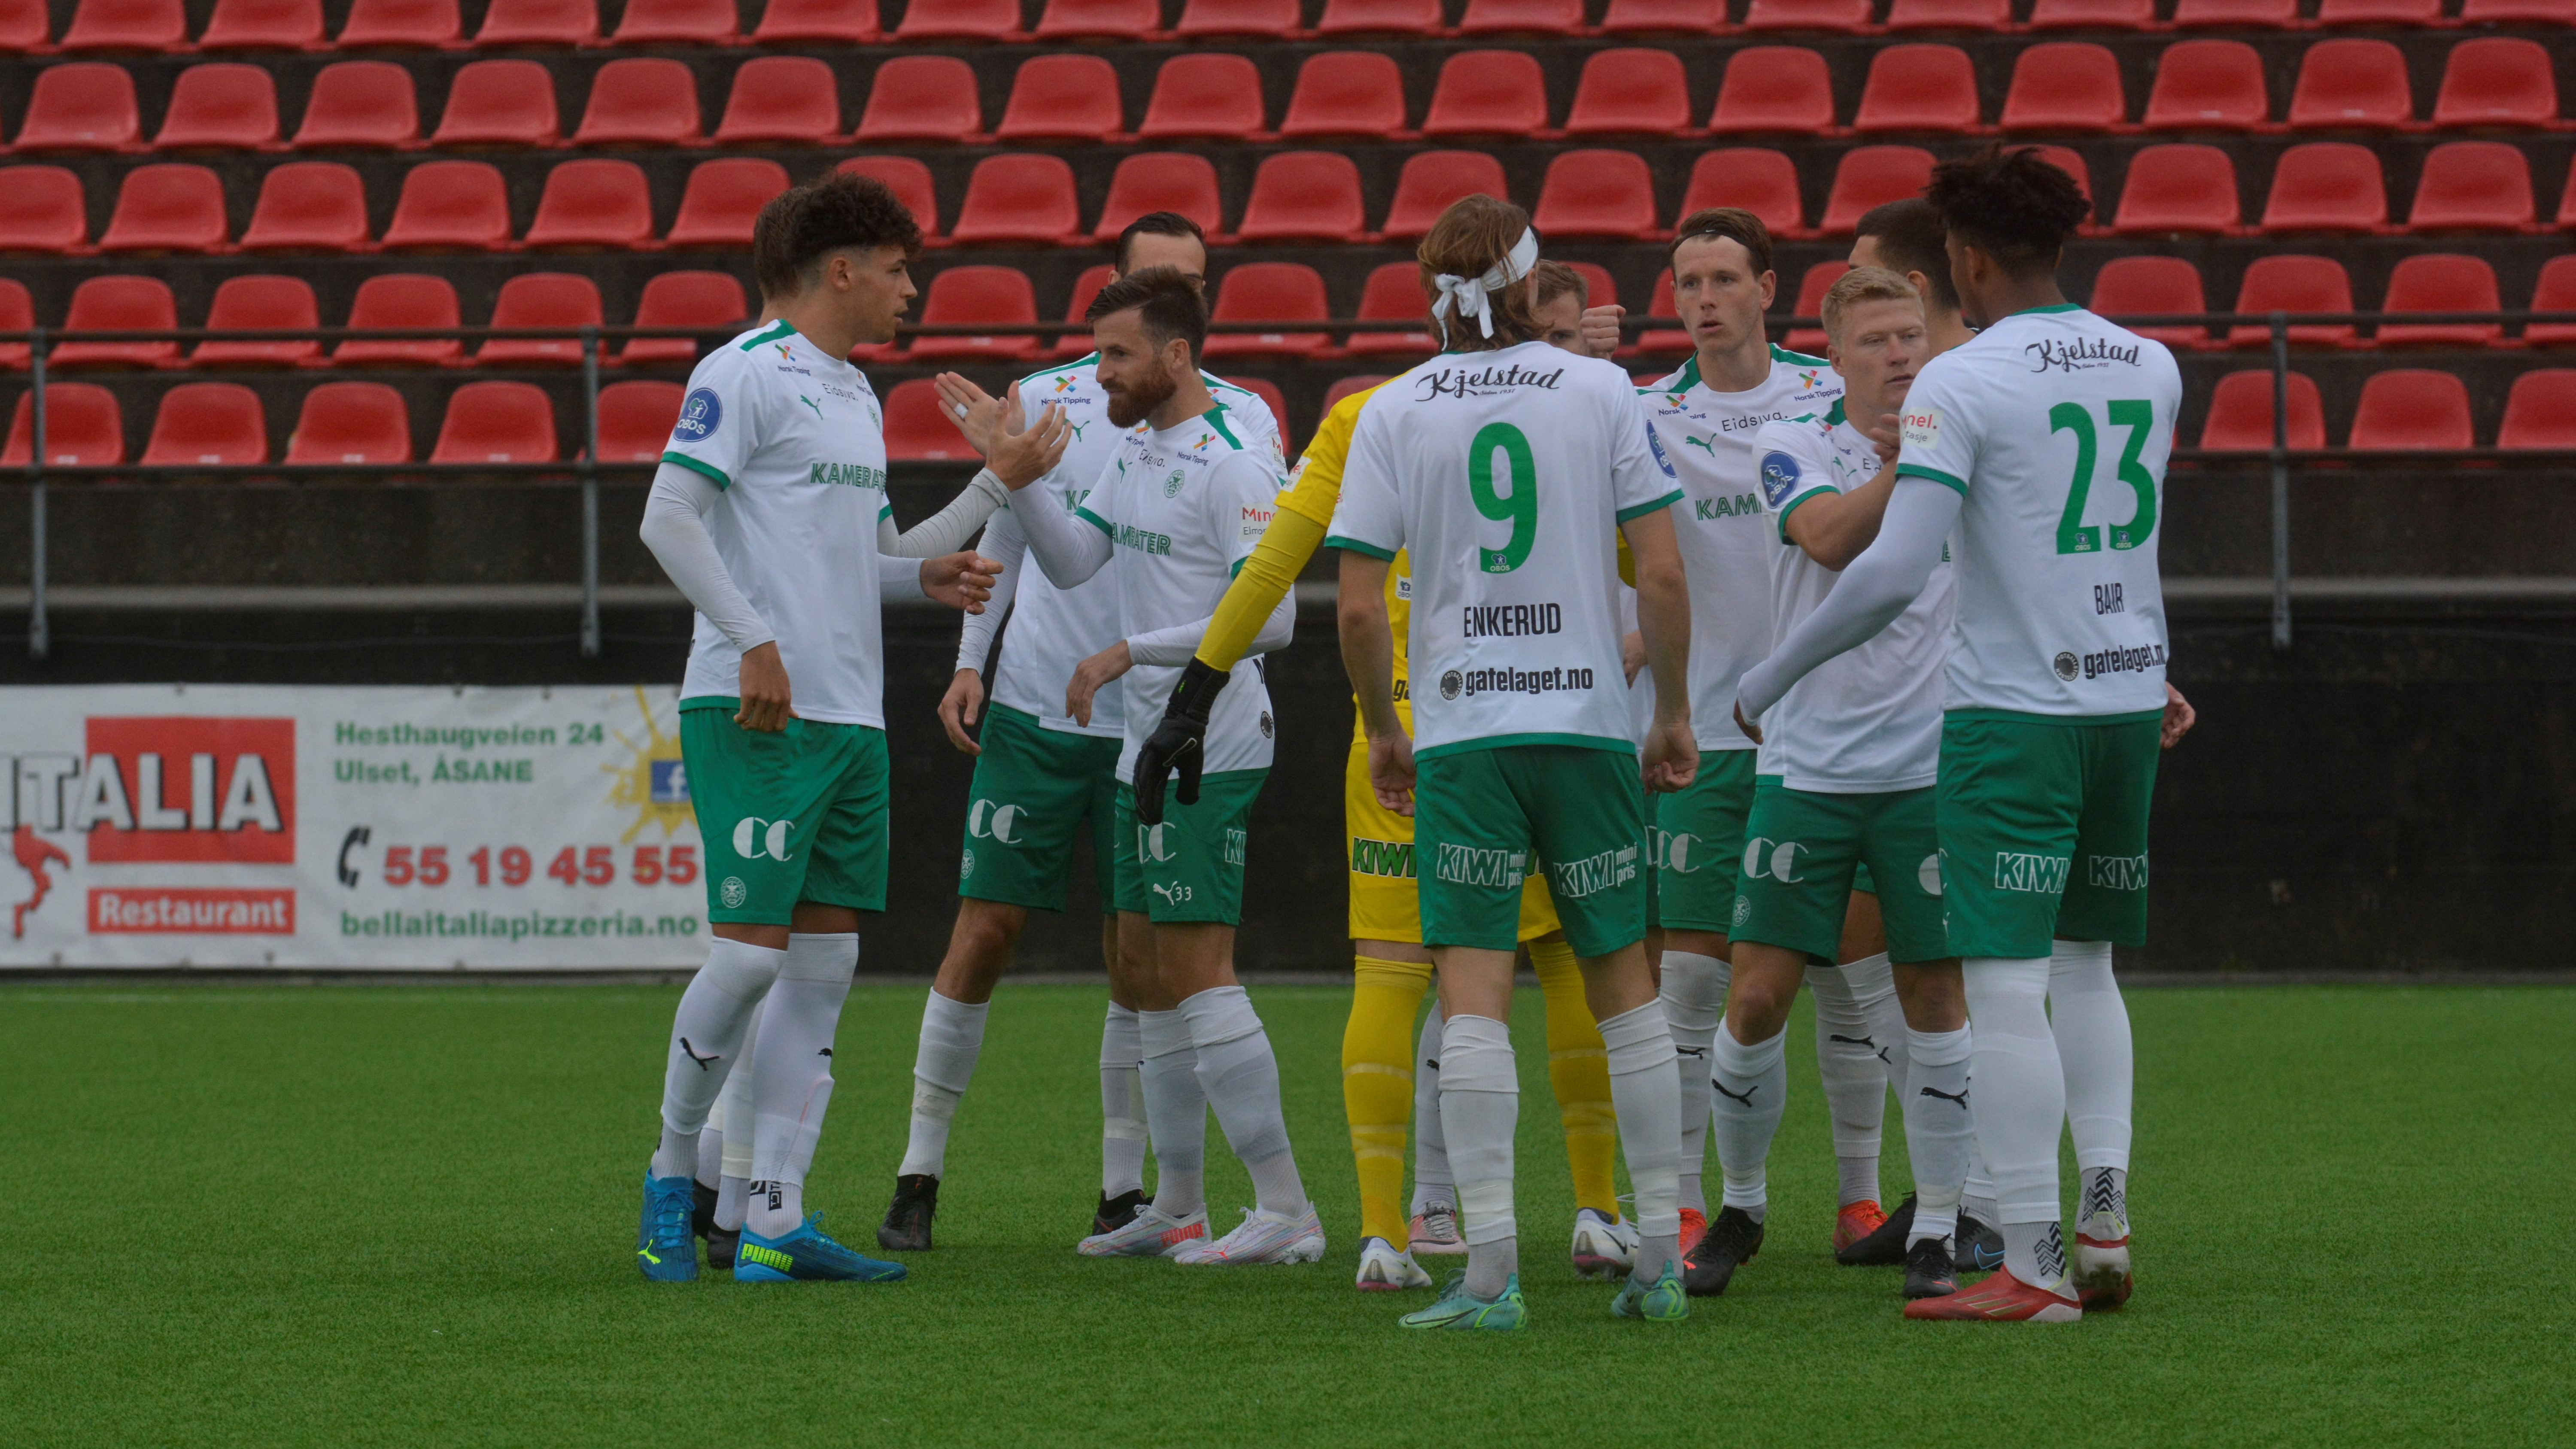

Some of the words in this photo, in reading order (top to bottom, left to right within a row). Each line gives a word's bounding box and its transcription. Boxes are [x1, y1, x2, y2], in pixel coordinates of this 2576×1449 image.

[2025, 337, 2142, 373] Kjelstad
[1415, 364, 1564, 402] Kjelstad
[1794, 392, 1816, 401] Norsk
[1815, 387, 1842, 398] Tipping
[677, 419, 706, 434] OBOS
[1177, 451, 1192, 461] Norsk
[1191, 455, 1209, 466] Tipping
[2049, 399, 2156, 555] 23
[1468, 422, 1537, 574] 9
[2094, 582, 2125, 615] BAIR
[1464, 603, 1561, 638] ENKERUD
[1466, 666, 1593, 696] gatelaget.no
[335, 722, 556, 750] Hesthaugveien
[568, 722, 605, 745] 24
[335, 759, 420, 787] Ulset,
[432, 750, 533, 783] ÅSANE
[384, 846, 451, 886] 55
[468, 846, 533, 886] 19
[548, 846, 615, 886] 45
[632, 846, 698, 886] 55
[1437, 842, 1508, 886] KIWI
[1509, 850, 1527, 868] mini
[1508, 868, 1522, 890] pris
[1553, 850, 1614, 897] KIWI
[1616, 841, 1637, 866] mini
[1617, 862, 1635, 887] pris
[99, 892, 287, 927] Restaurant
[1176, 886, 1192, 901] 33
[342, 911, 698, 940] bellaitaliapizzeria.no
[741, 1243, 793, 1272] PUMA
